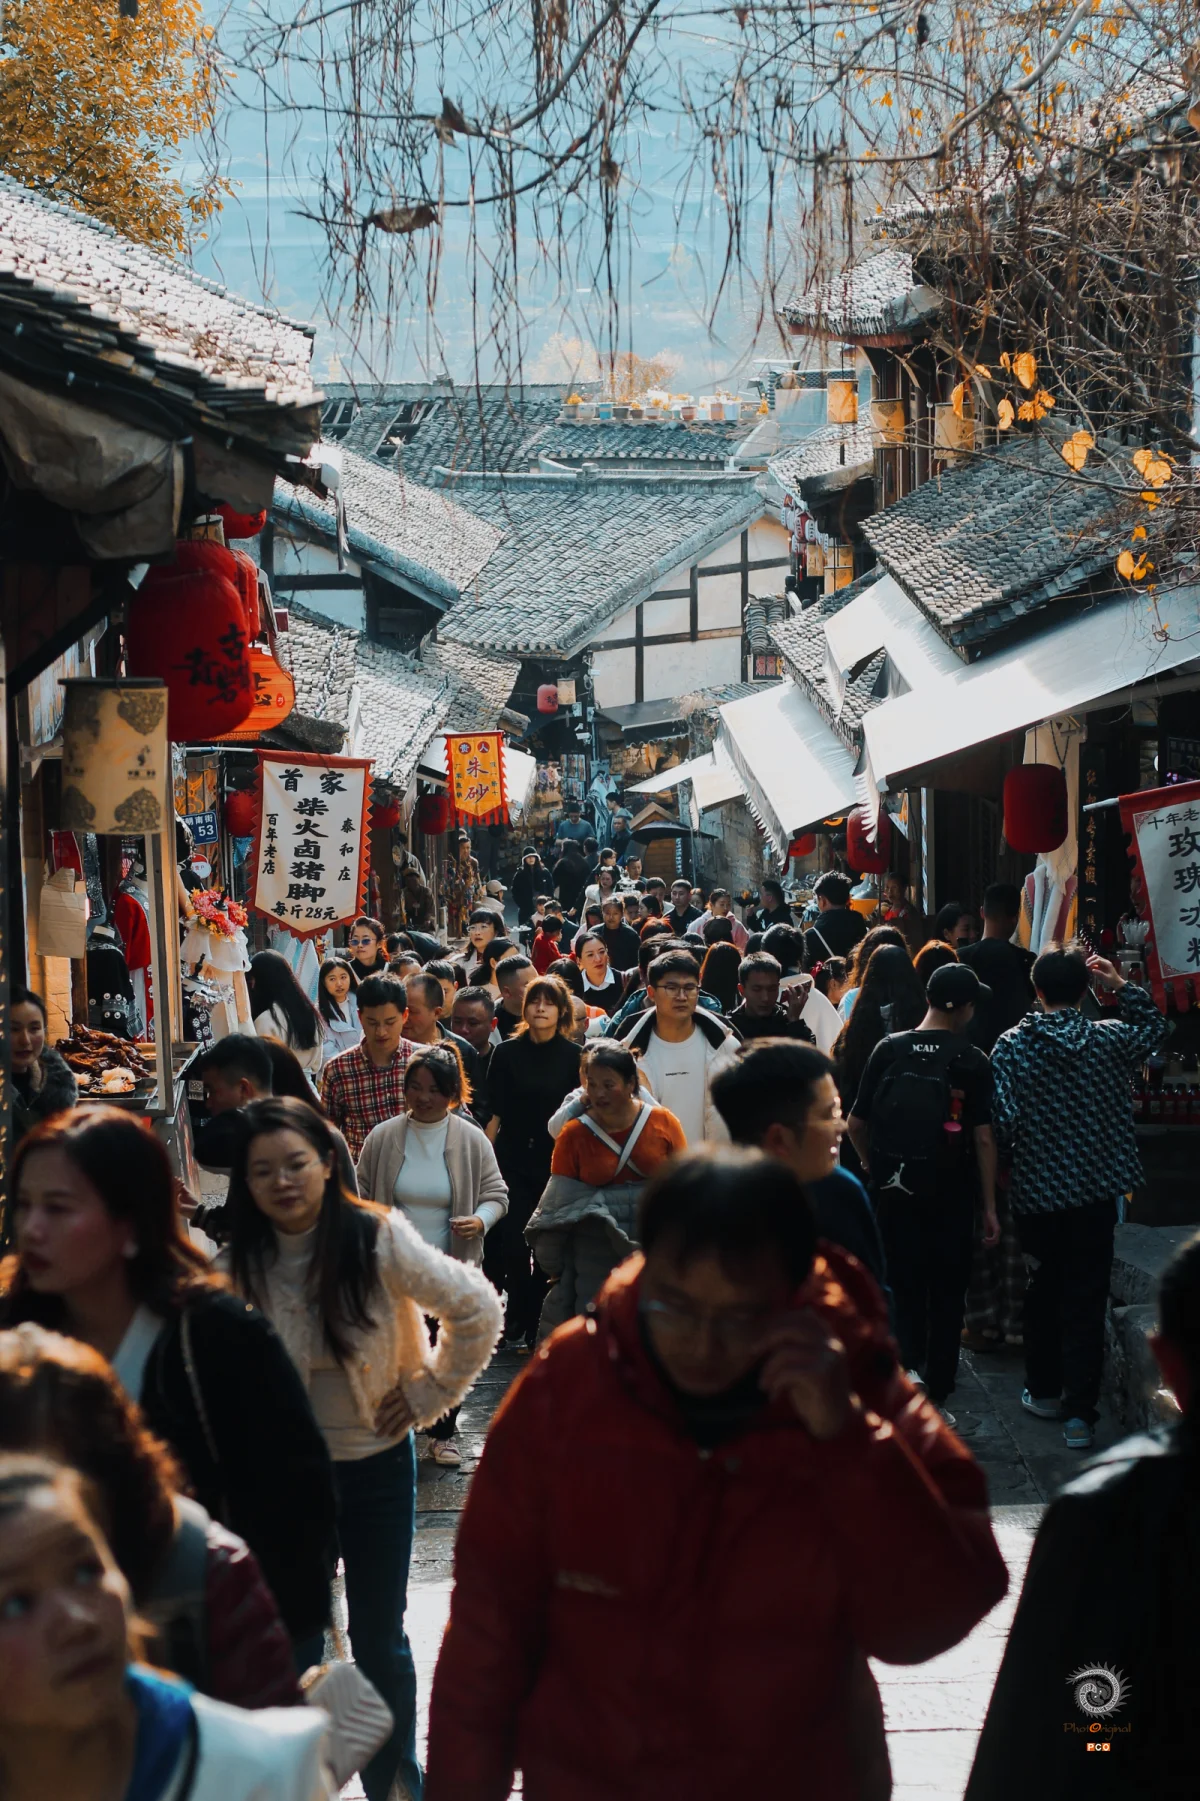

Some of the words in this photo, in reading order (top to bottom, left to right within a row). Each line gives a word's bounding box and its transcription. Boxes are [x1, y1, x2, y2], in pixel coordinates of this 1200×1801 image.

[459, 743, 489, 753] 贵人
[279, 768, 347, 795] 首家
[464, 757, 490, 803] 朱砂
[198, 825, 214, 837] 53
[262, 813, 279, 875] 百年老店
[286, 797, 329, 903] 柴火卤猪脚
[271, 901, 339, 920] 每斤28元
